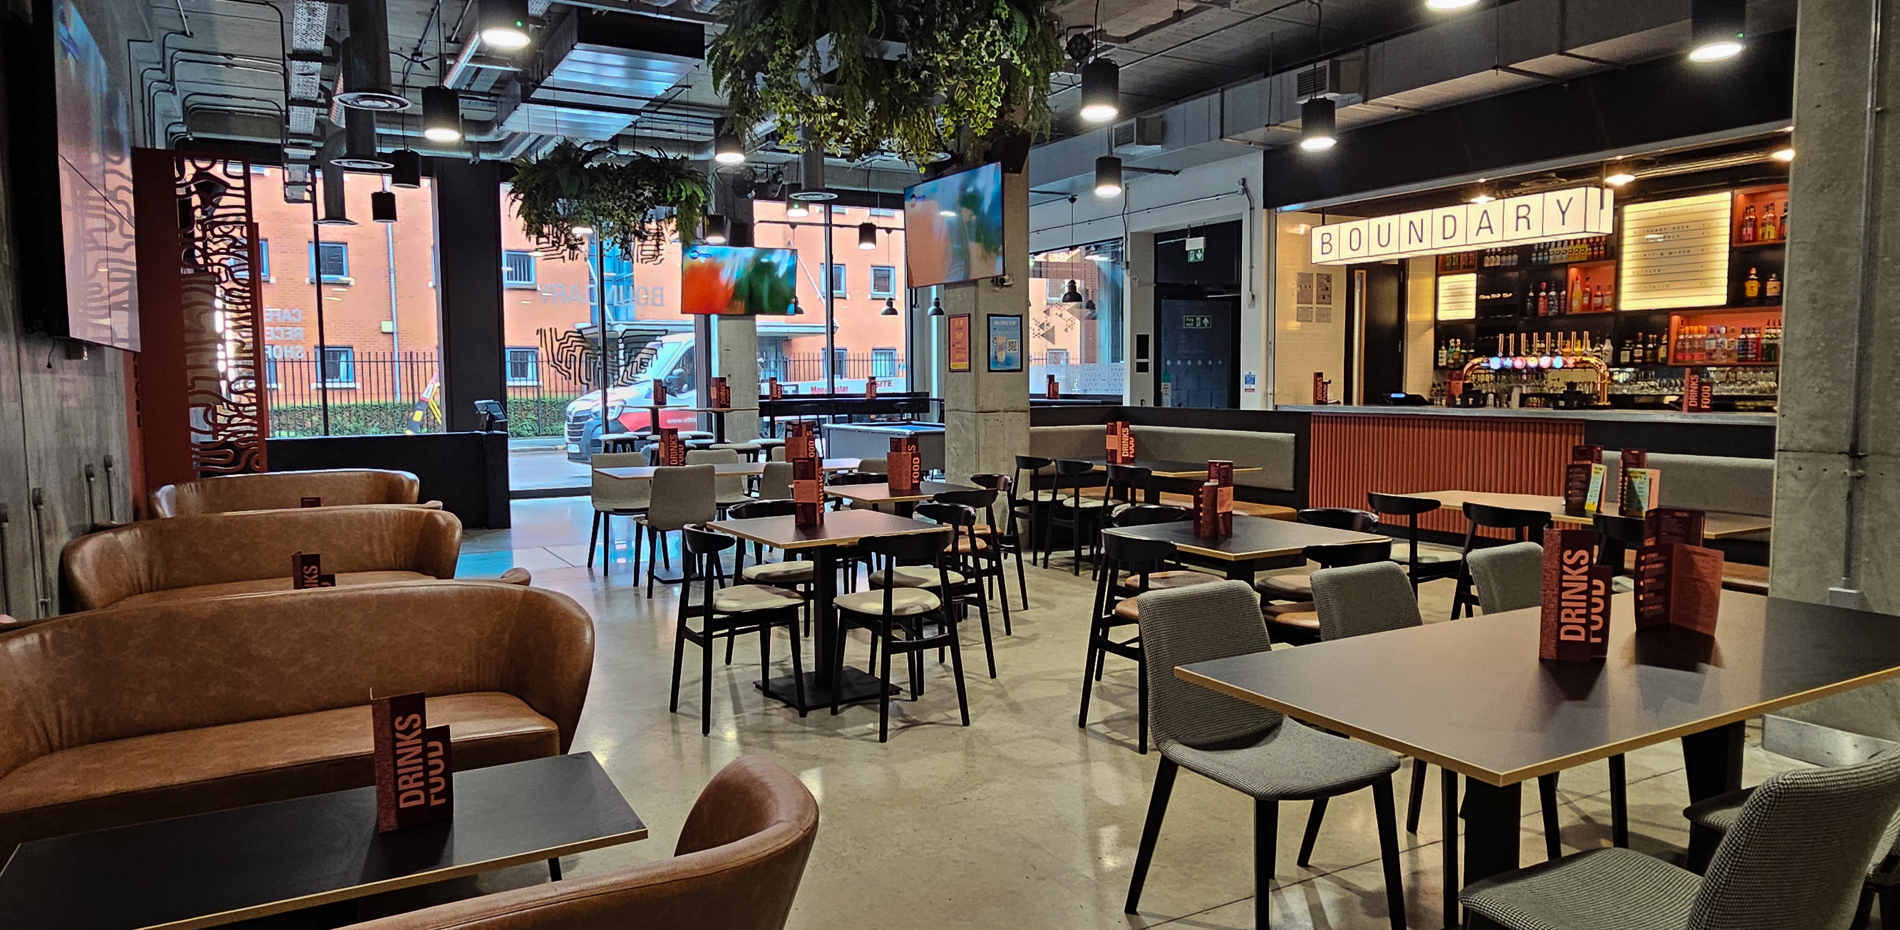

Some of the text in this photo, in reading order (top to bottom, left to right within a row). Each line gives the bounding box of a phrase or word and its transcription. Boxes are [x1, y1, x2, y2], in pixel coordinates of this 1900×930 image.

[1320, 197, 1574, 256] BOUNDARY
[1689, 374, 1699, 407] DRINKS
[1701, 385, 1711, 409] FOOD
[669, 434, 678, 466] DRINKS
[1121, 427, 1130, 457] DRINKS
[912, 456, 920, 484] FOOD
[1560, 549, 1590, 641] DRINKS
[394, 713, 425, 809] DRINKS
